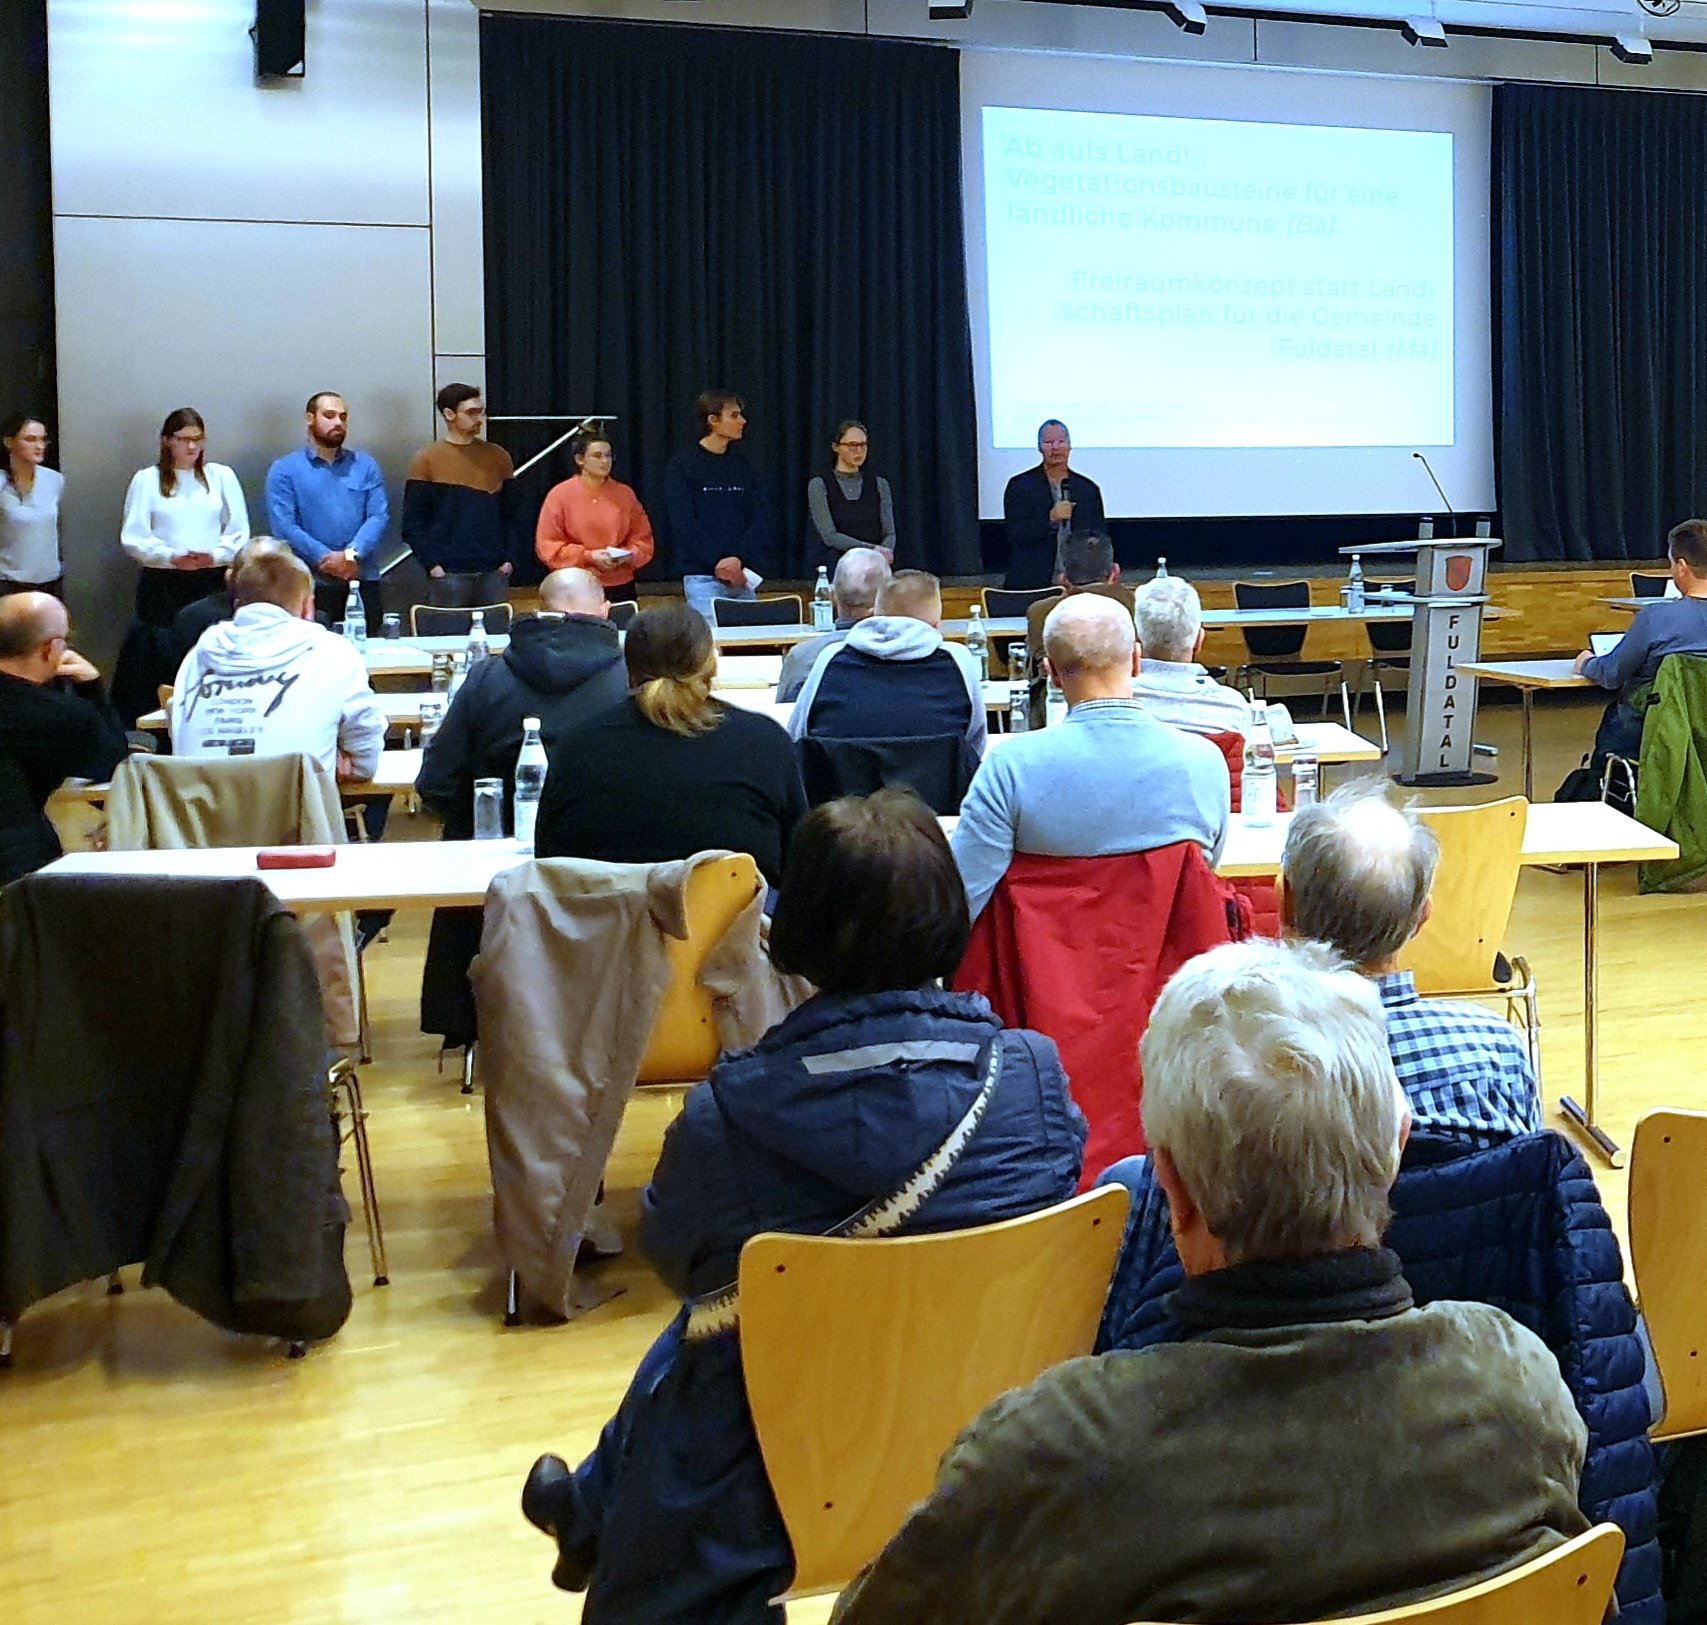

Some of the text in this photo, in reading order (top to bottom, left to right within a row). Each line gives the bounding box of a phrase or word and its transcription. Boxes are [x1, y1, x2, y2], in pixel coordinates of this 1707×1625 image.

[1005, 136, 1190, 166] Ab aufs Land!
[1006, 168, 1400, 206] Vegetationsbausteine für eine
[1007, 201, 1336, 238] ländliche Kommune (Ba)
[1072, 270, 1296, 299] Freiraumkonzept
[1303, 278, 1360, 297] statt
[1061, 302, 1214, 326] schaftsplan
[1266, 306, 1304, 326] die
[1312, 306, 1438, 329] Gemeinde
[1278, 338, 1377, 359] Fuldatal
[1439, 614, 1460, 768] FULDATAL
